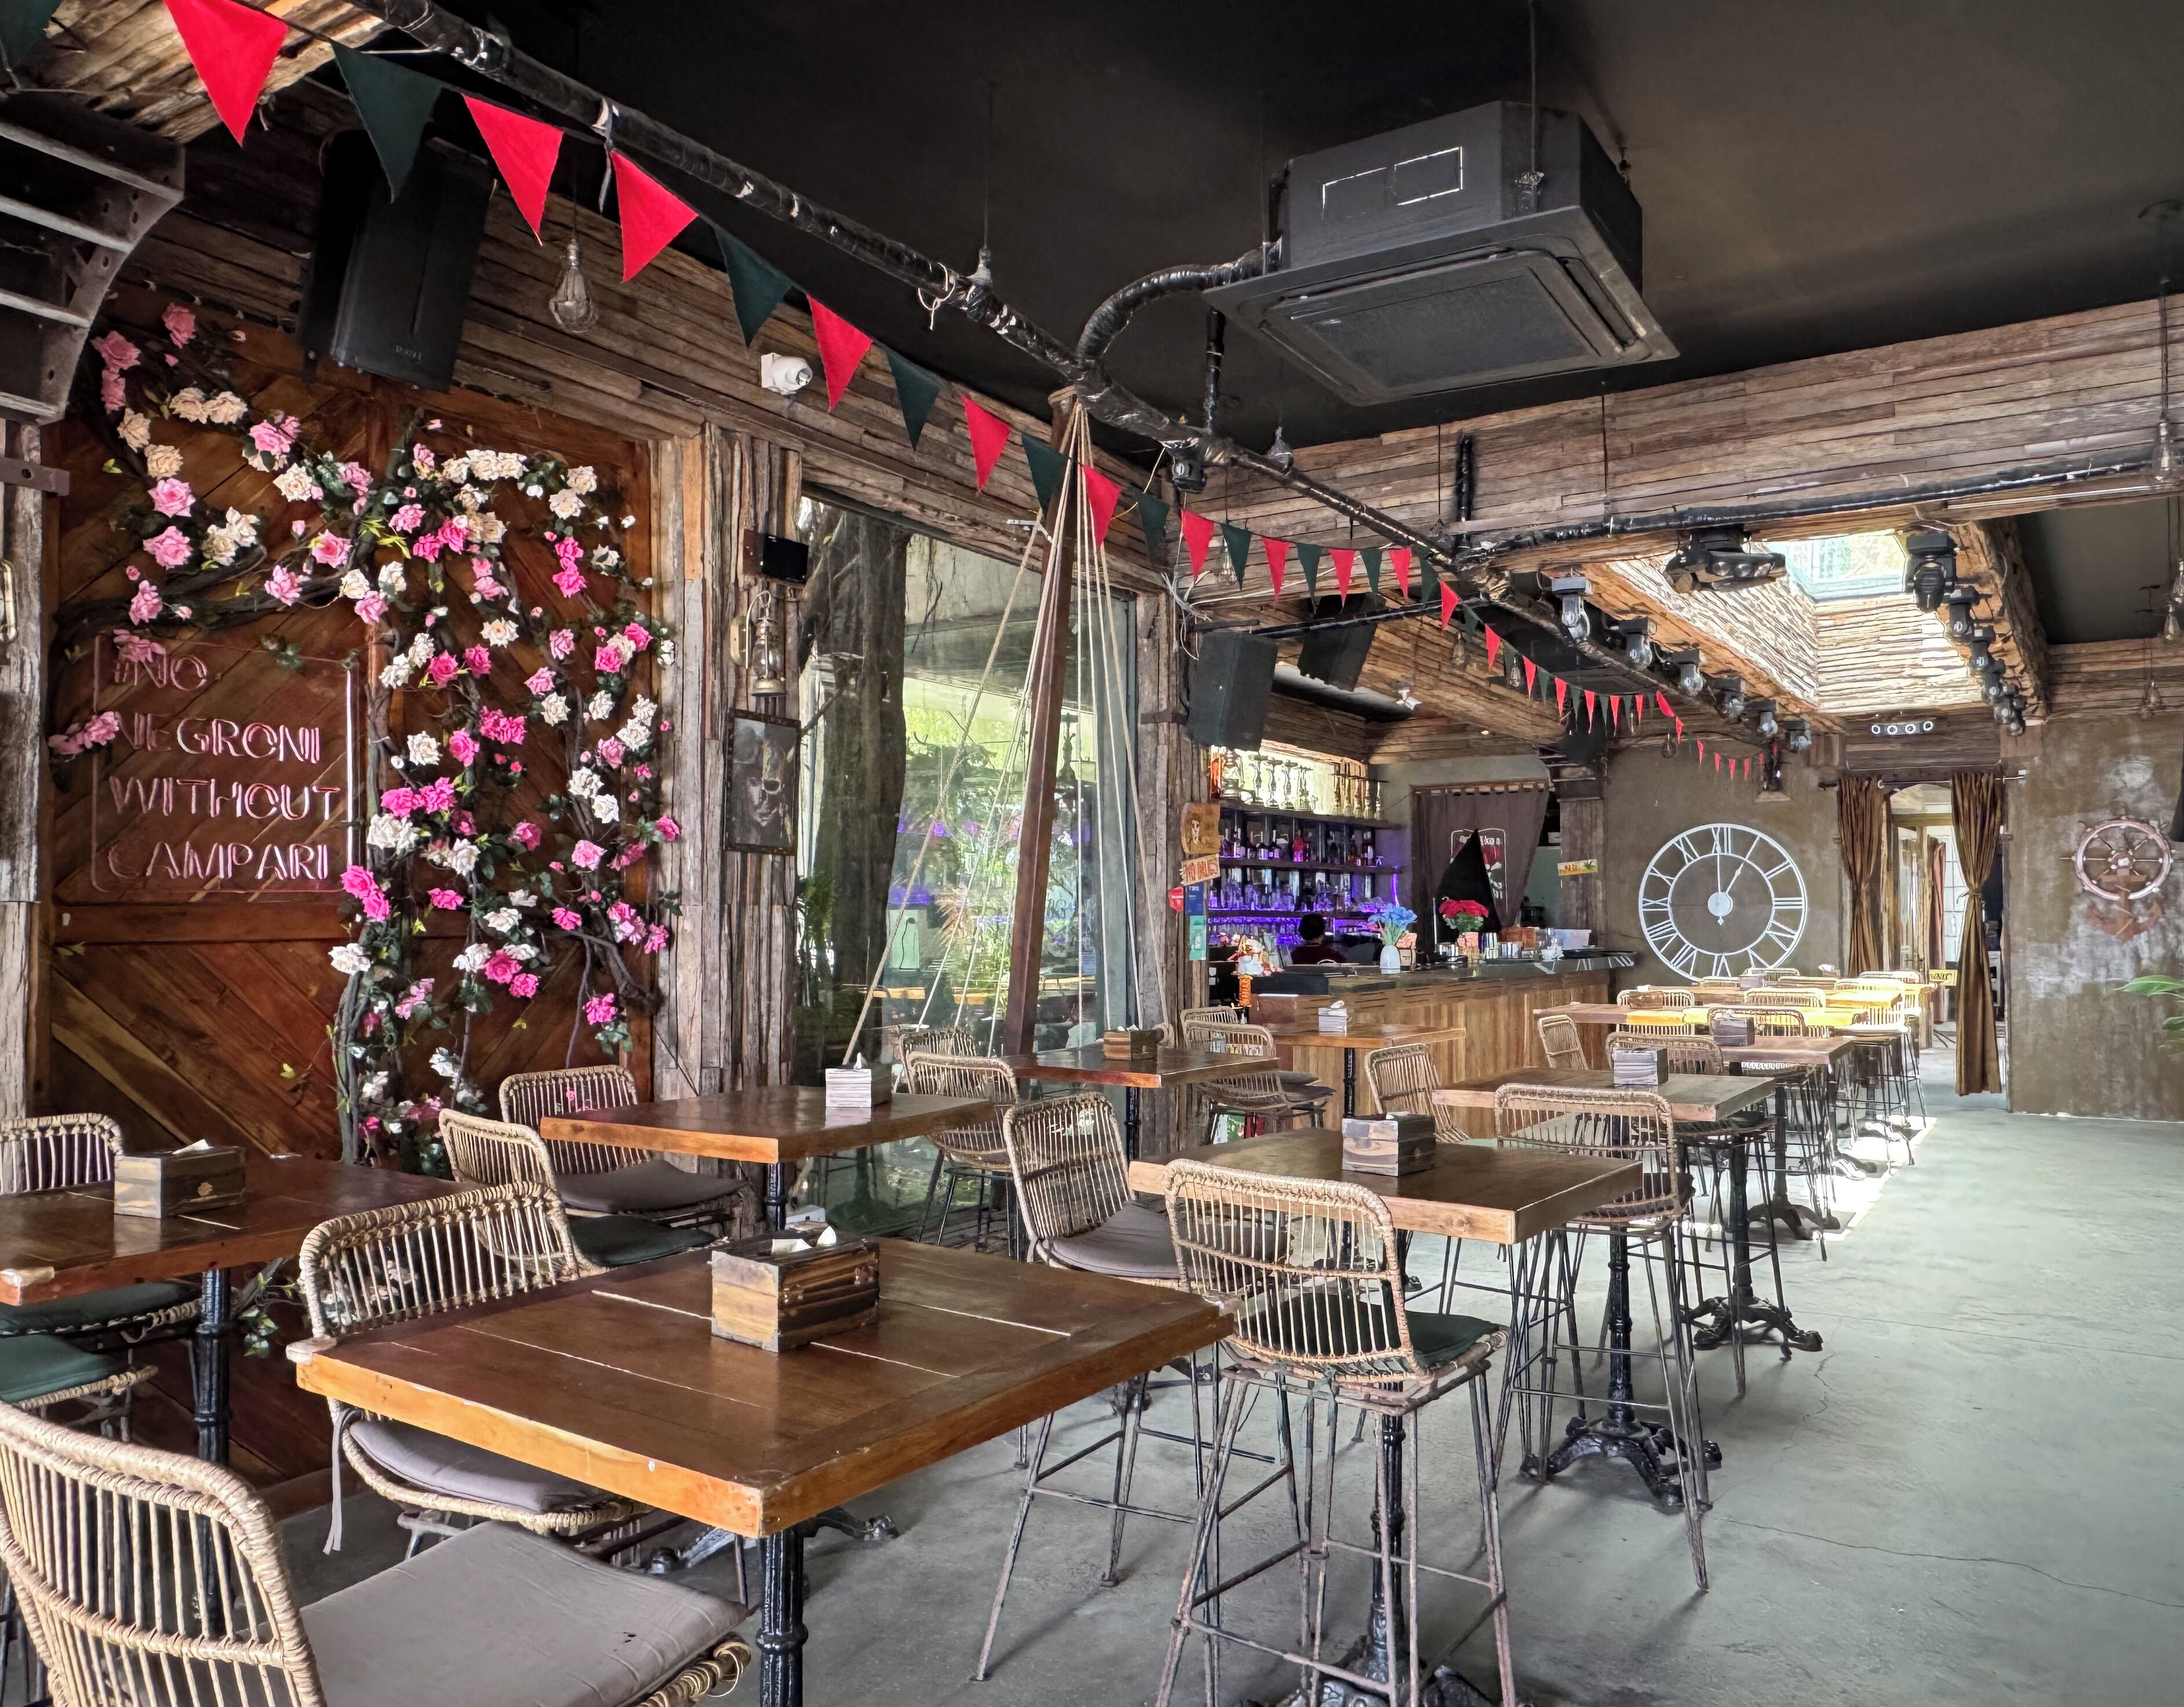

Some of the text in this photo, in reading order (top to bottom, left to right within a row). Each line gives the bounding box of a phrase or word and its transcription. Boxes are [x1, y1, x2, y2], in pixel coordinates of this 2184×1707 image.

[115, 711, 321, 765] NEGRONI
[108, 776, 341, 821] WITHOUT
[107, 840, 329, 880] CAMPARI
